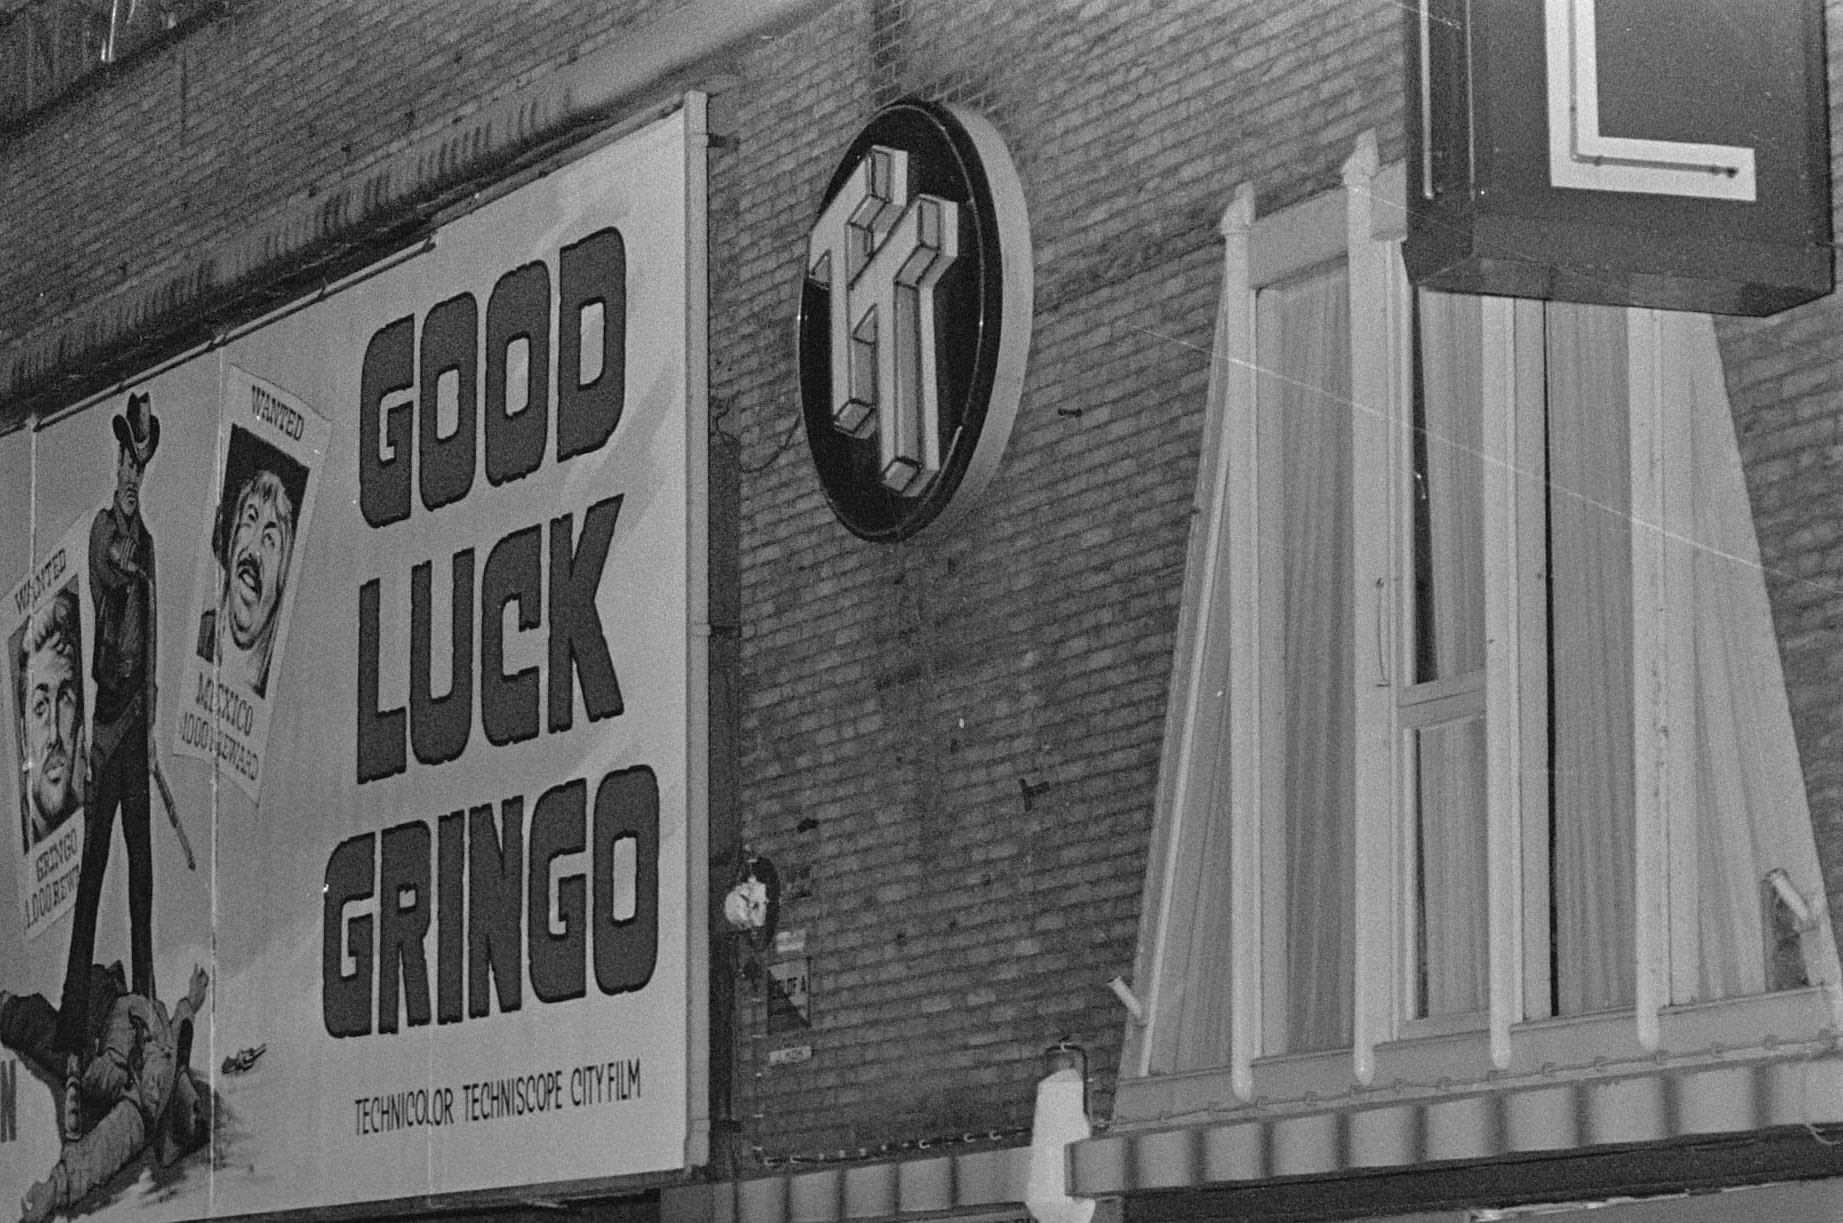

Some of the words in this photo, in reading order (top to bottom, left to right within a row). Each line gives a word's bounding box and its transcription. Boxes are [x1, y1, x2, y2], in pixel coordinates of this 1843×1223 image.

[252, 385, 305, 442] WANTED
[359, 225, 627, 529] GOOD
[15, 549, 67, 615] WANTED
[357, 494, 625, 785] LUCK
[195, 671, 254, 737] MEXICO
[322, 764, 660, 1039] GRINGO
[355, 1087, 454, 1136] TECHNICOLOR
[463, 1070, 562, 1122] TECHNISCOPE
[570, 1063, 605, 1107] CITY
[607, 1057, 640, 1103] FILM
